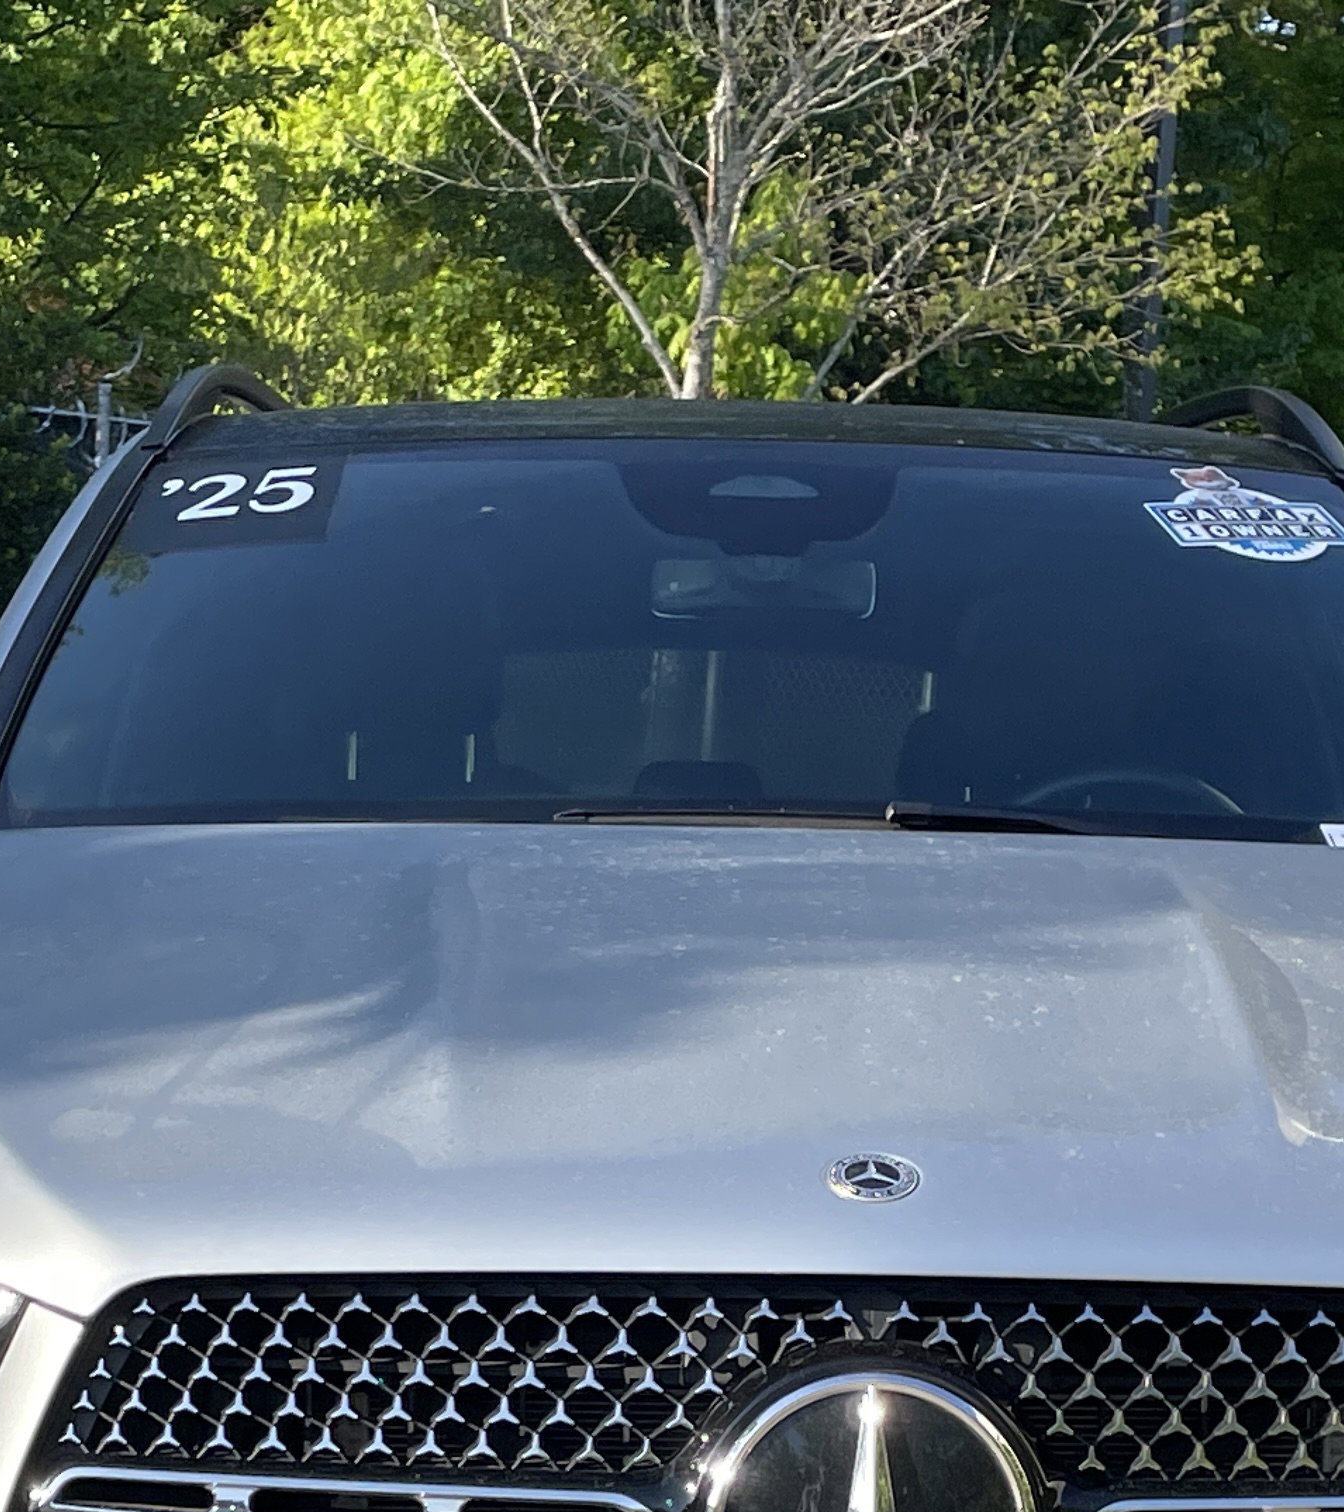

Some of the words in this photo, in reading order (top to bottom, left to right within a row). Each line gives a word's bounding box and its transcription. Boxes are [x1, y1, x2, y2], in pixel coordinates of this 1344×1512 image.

[161, 466, 318, 522] '25
[1165, 507, 1323, 523] CARFAX
[1182, 524, 1199, 538] 1
[1208, 524, 1337, 538] OWNER
